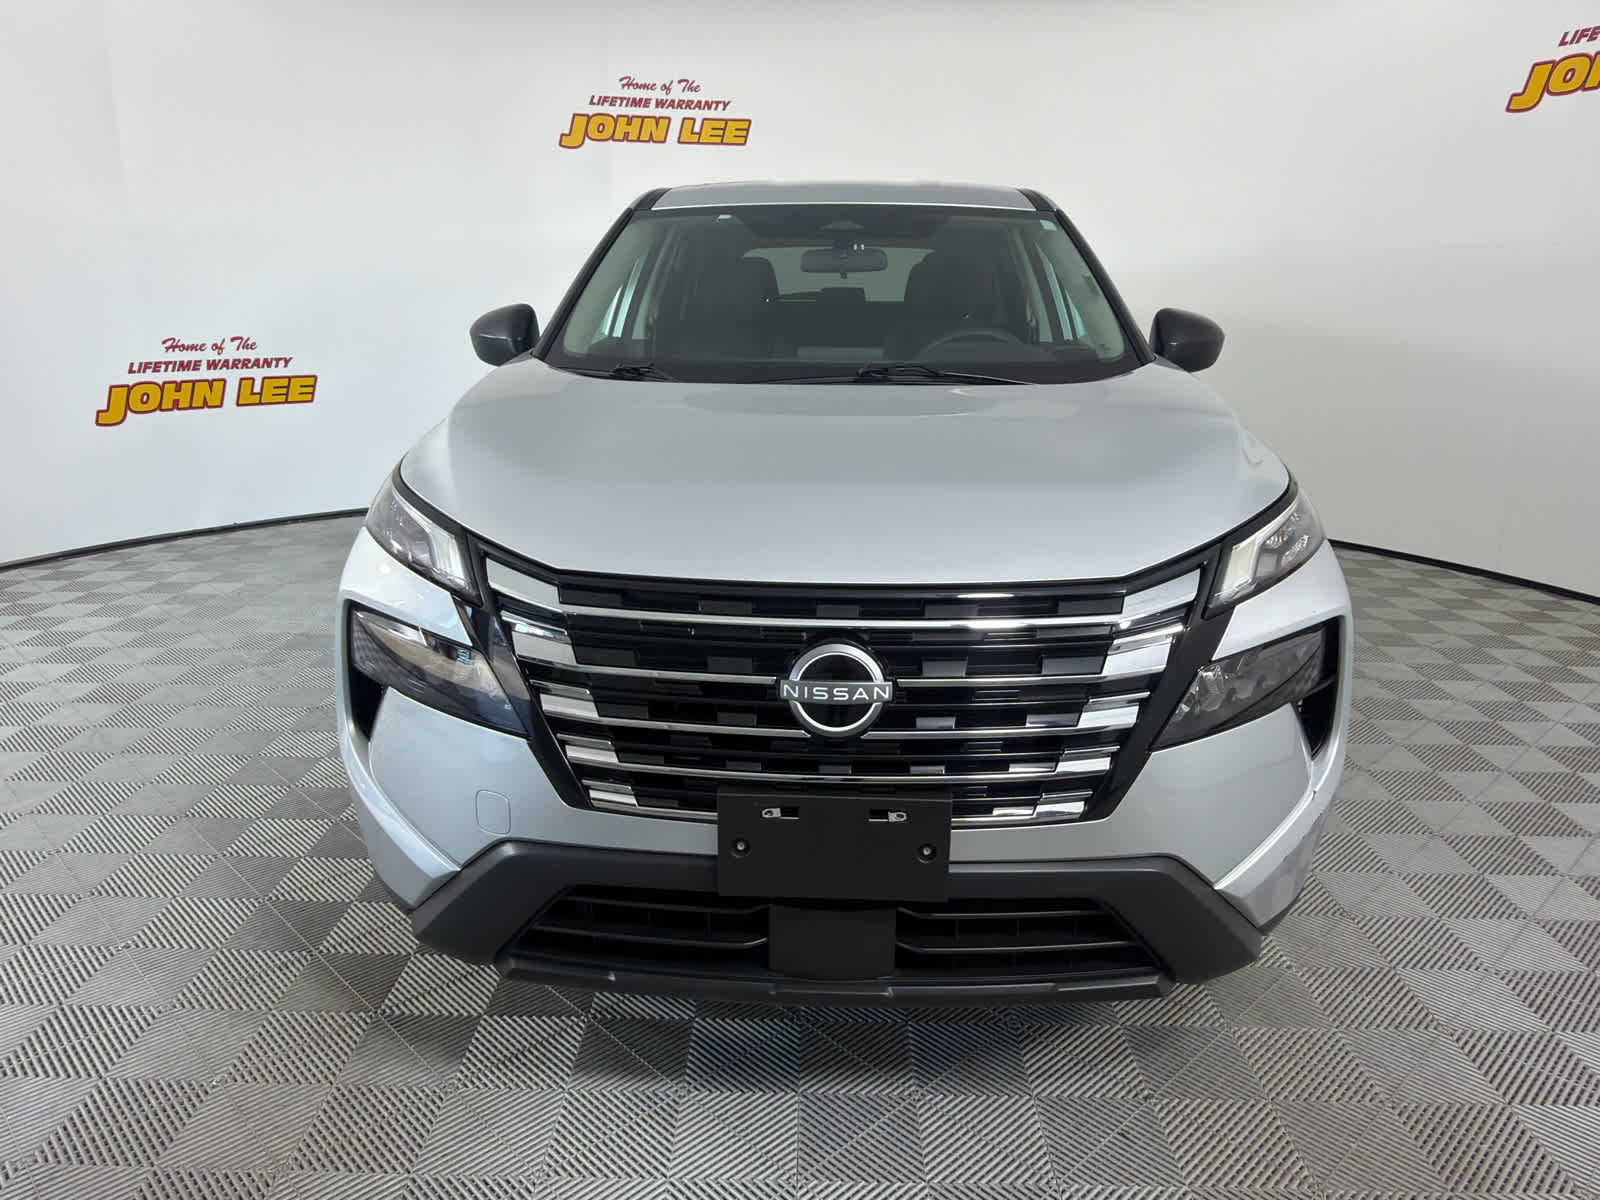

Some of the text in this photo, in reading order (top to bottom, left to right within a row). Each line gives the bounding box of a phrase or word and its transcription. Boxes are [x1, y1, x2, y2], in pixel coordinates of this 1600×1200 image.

[618, 76, 702, 96] Home of The
[588, 95, 731, 111] LIFETIME WARRANTY
[559, 113, 752, 149] JOHN LEE
[161, 336, 258, 355] Home of The
[127, 357, 293, 374] LIFETIME WARRANTY
[95, 374, 318, 427] JOHN LEE
[783, 684, 889, 701] NISSAN
